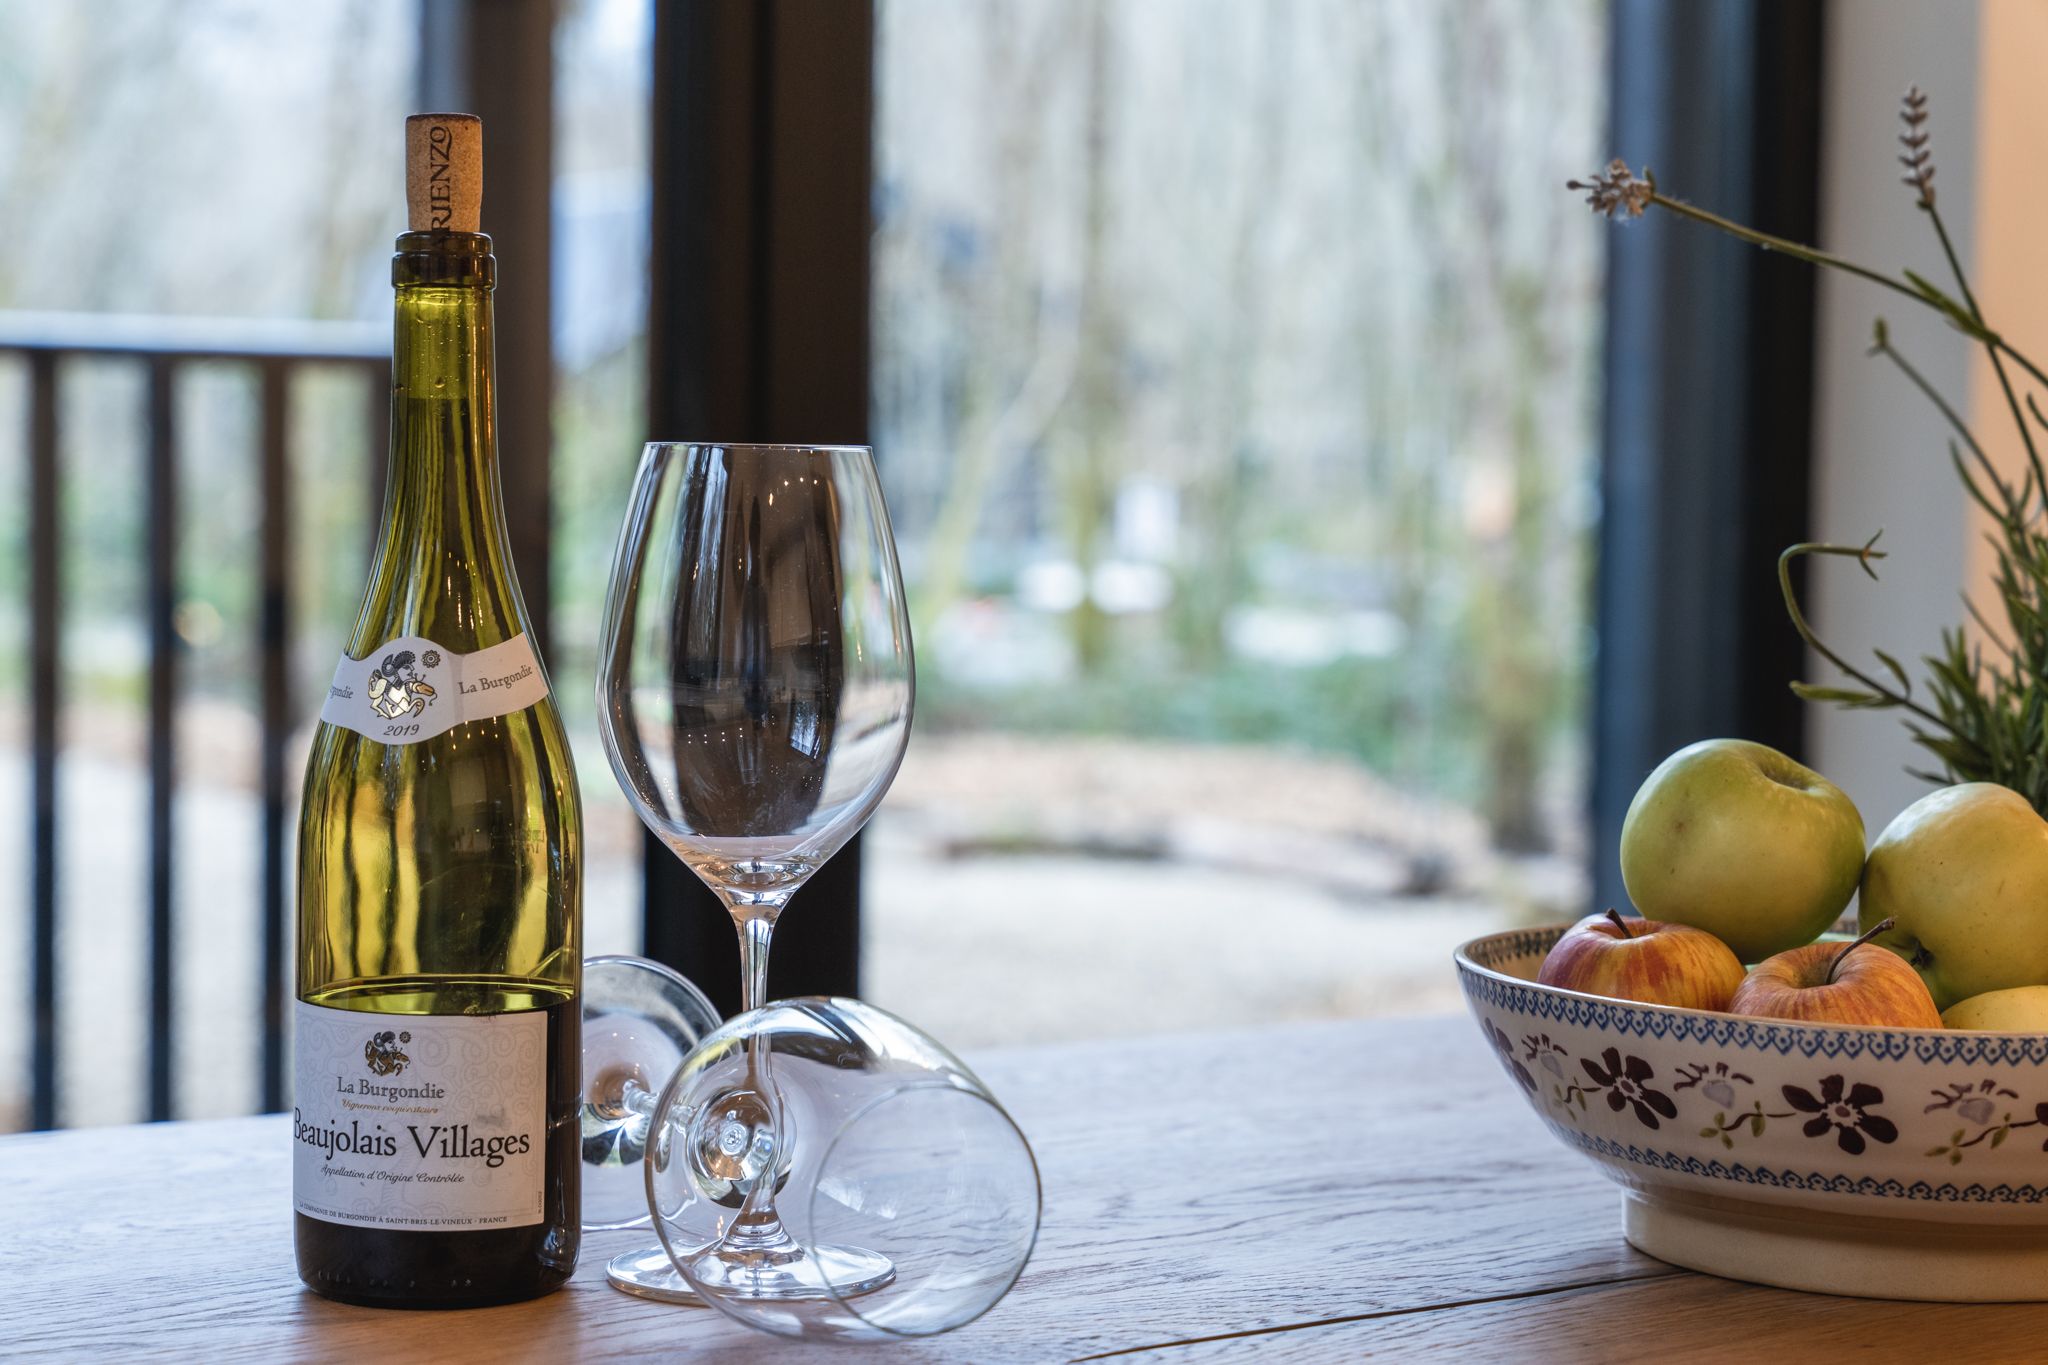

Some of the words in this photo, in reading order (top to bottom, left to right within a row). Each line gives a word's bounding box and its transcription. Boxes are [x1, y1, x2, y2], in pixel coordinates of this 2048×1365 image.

[429, 126, 453, 233] RIENZO
[457, 681, 477, 694] La
[478, 664, 533, 689] Burgondie
[329, 686, 353, 699] gondie
[383, 724, 420, 737] 2019
[336, 1076, 355, 1094] La
[358, 1078, 446, 1103] Burgondie
[294, 1107, 397, 1161] Beaujolais
[407, 1123, 531, 1168] Villages
[320, 1164, 365, 1179] Appellation
[416, 1172, 465, 1183] Contrôlée
[329, 1210, 337, 1218] DE
[338, 1212, 377, 1222] BURGONDIE
[479, 1216, 508, 1224] FRANCE
